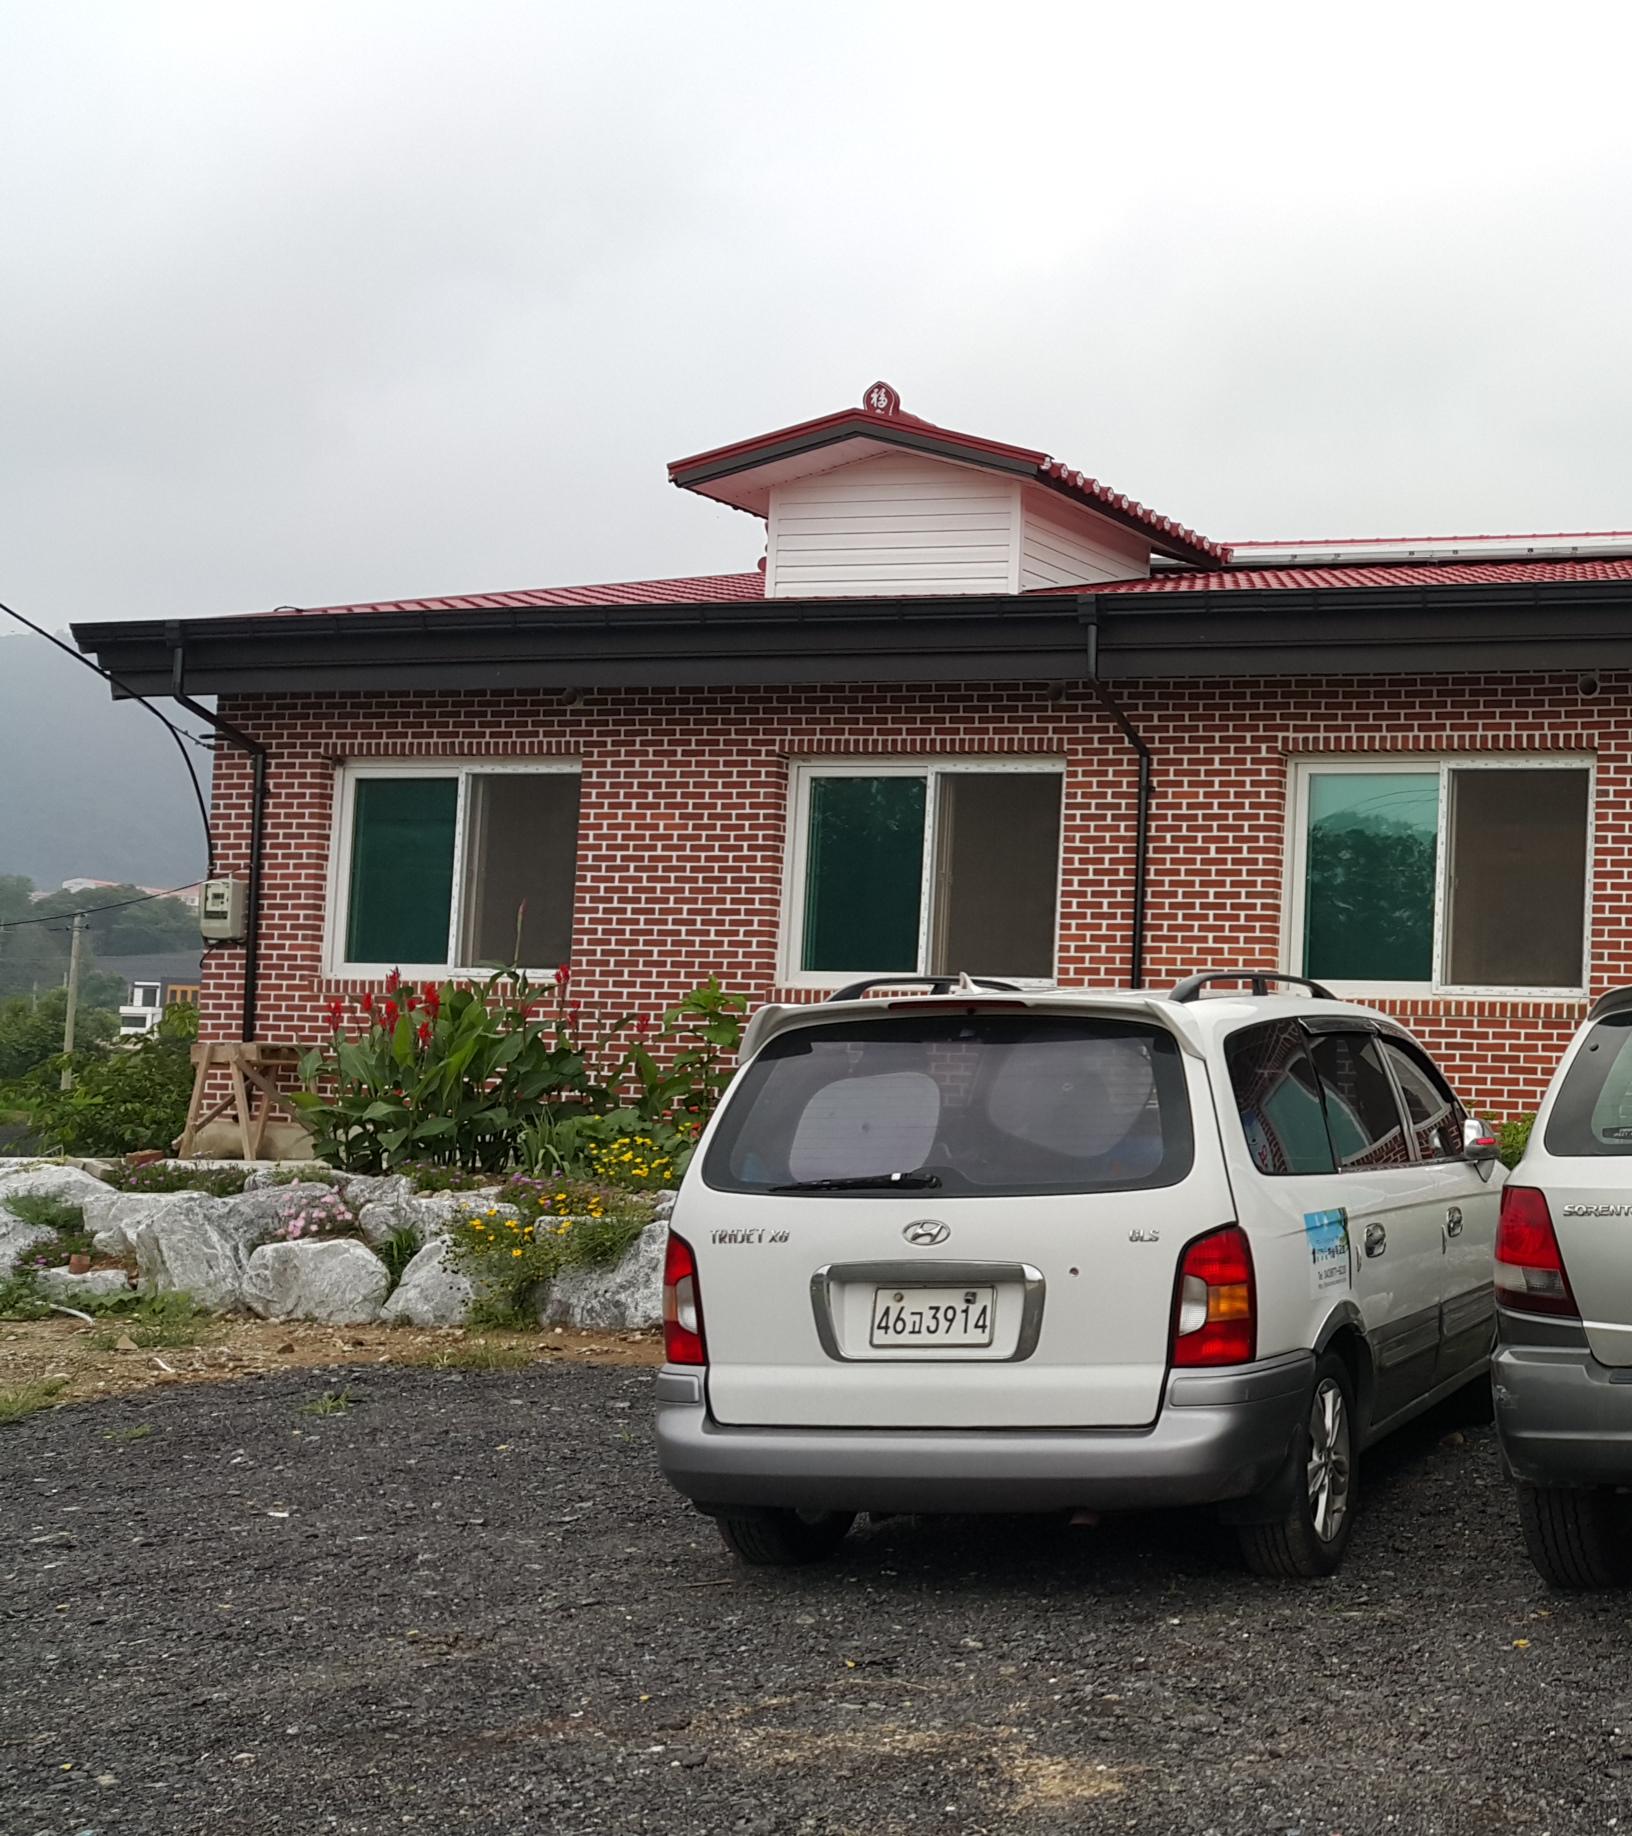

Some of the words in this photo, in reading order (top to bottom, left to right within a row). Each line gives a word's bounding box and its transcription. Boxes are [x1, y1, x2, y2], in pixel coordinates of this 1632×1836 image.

[710, 1229, 765, 1244] TRAJET
[1129, 1229, 1159, 1242] GLS
[877, 1304, 988, 1335] 46고3914
